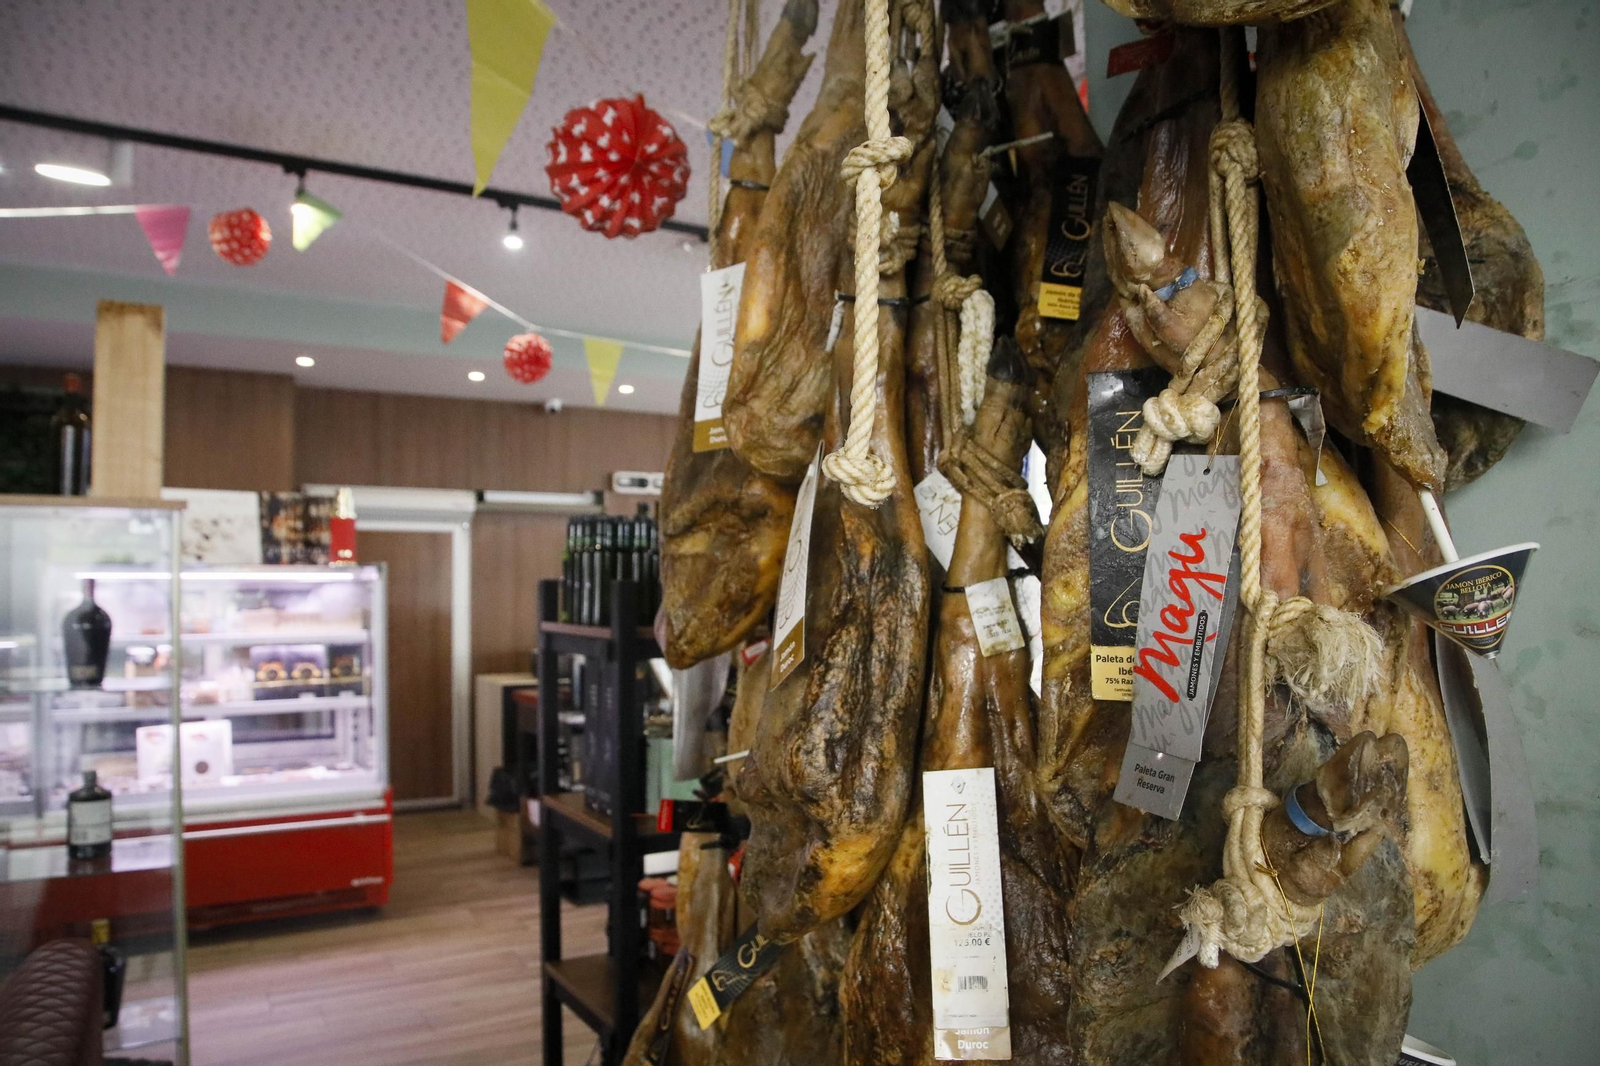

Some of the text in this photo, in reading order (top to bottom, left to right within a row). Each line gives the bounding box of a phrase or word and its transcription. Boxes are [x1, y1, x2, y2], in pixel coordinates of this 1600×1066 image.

[1460, 582, 1492, 594] BELLOTA
[1096, 655, 1124, 663] Paleta
[1188, 662, 1200, 697] JAMONES
[1195, 614, 1206, 656] EMBUTIDOS
[1134, 763, 1175, 782] Paleta Gran
[1136, 778, 1166, 794] Reserva
[943, 803, 982, 926] GUILLÉN
[957, 1039, 989, 1050] Duroc
